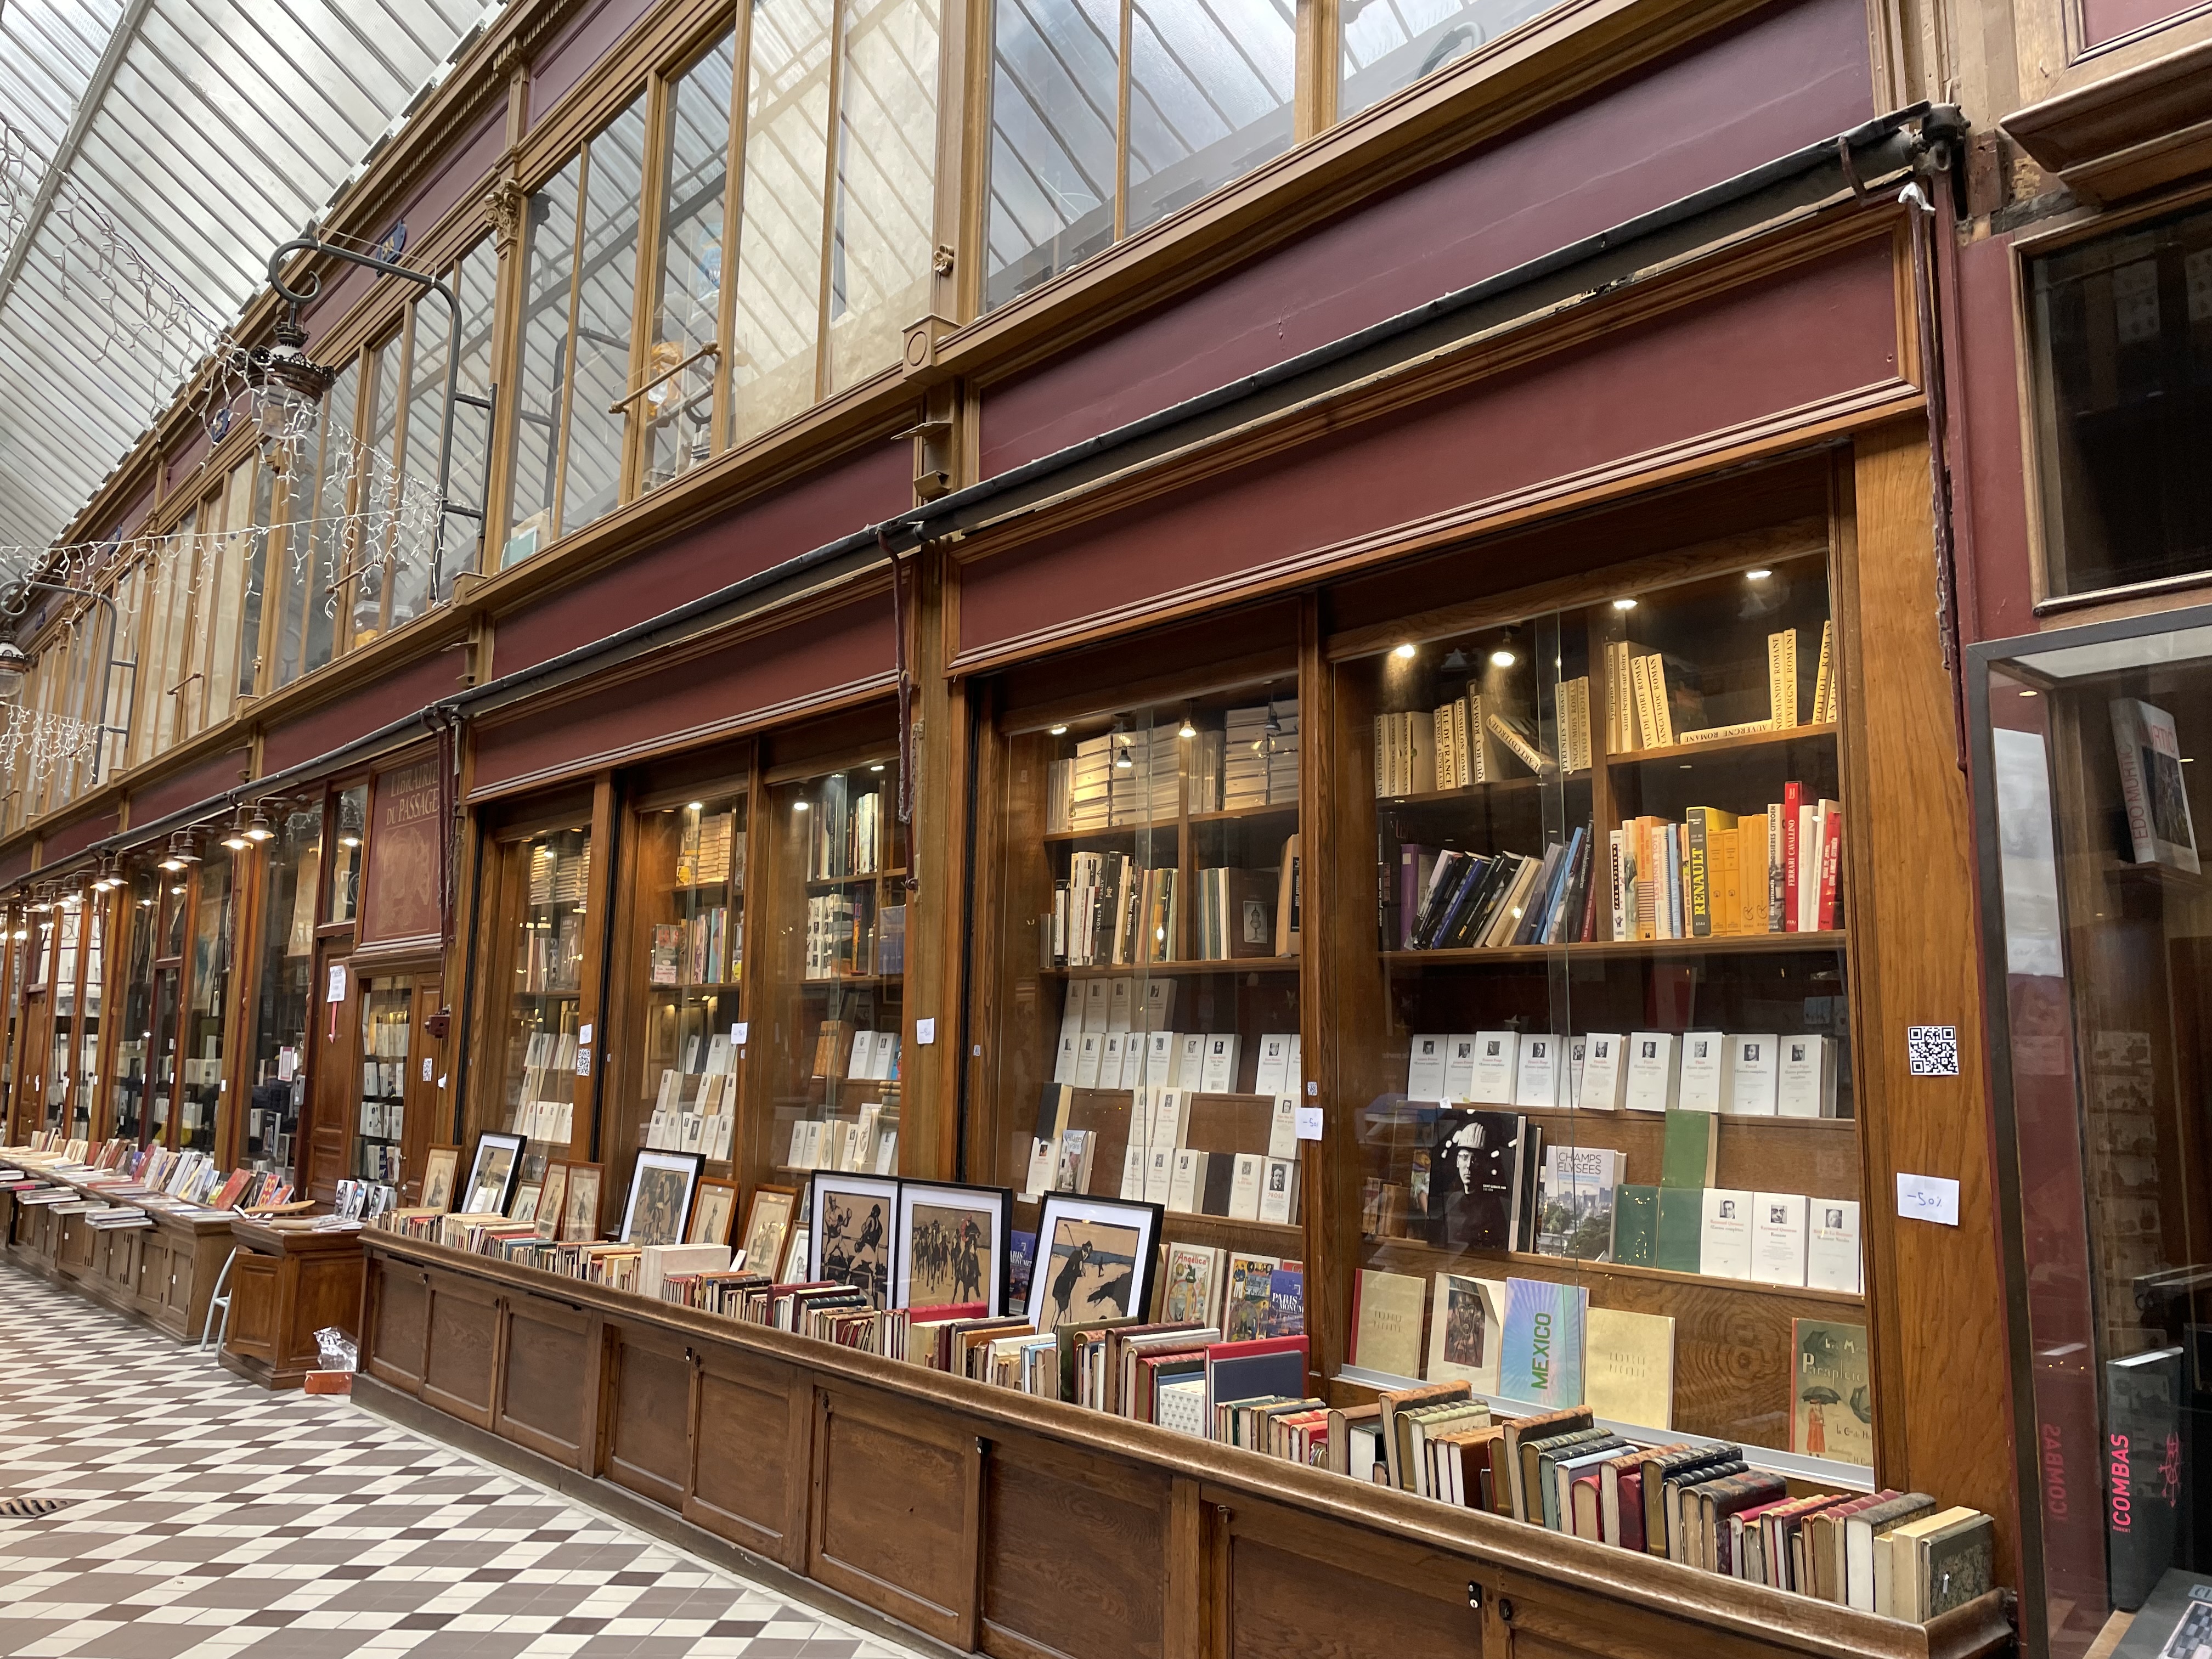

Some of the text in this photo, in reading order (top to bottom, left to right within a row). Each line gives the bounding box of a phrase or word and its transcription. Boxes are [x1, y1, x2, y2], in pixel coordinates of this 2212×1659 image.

[1634, 658, 1646, 691] ROMAN
[1815, 623, 1831, 721] POITOU ROMAN
[1639, 691, 1647, 718] LOIRE
[1649, 658, 1667, 744] LANGUEDOC ROMAN
[1442, 709, 1452, 786] ILE-DE-FRANCE
[1488, 716, 1520, 752] CISTERCIEN
[1684, 723, 1767, 743] AUVERGNE ROMANE
[390, 760, 439, 798] LIBRAIRIE
[386, 788, 439, 826] DU PASSAGE
[2129, 805, 2148, 839] EDO
[1692, 848, 1706, 916] RENAULT
[1558, 1161, 1601, 1175] ELYSEES
[1559, 1152, 1602, 1164] CHAMPS
[1175, 1251, 1207, 1266] Angélica
[1272, 1293, 1297, 1305] PARIS
[1531, 1313, 1551, 1390] MEXICO
[1802, 1353, 1864, 1386] Parapluie
[2110, 1433, 2131, 1527] COMBAS
